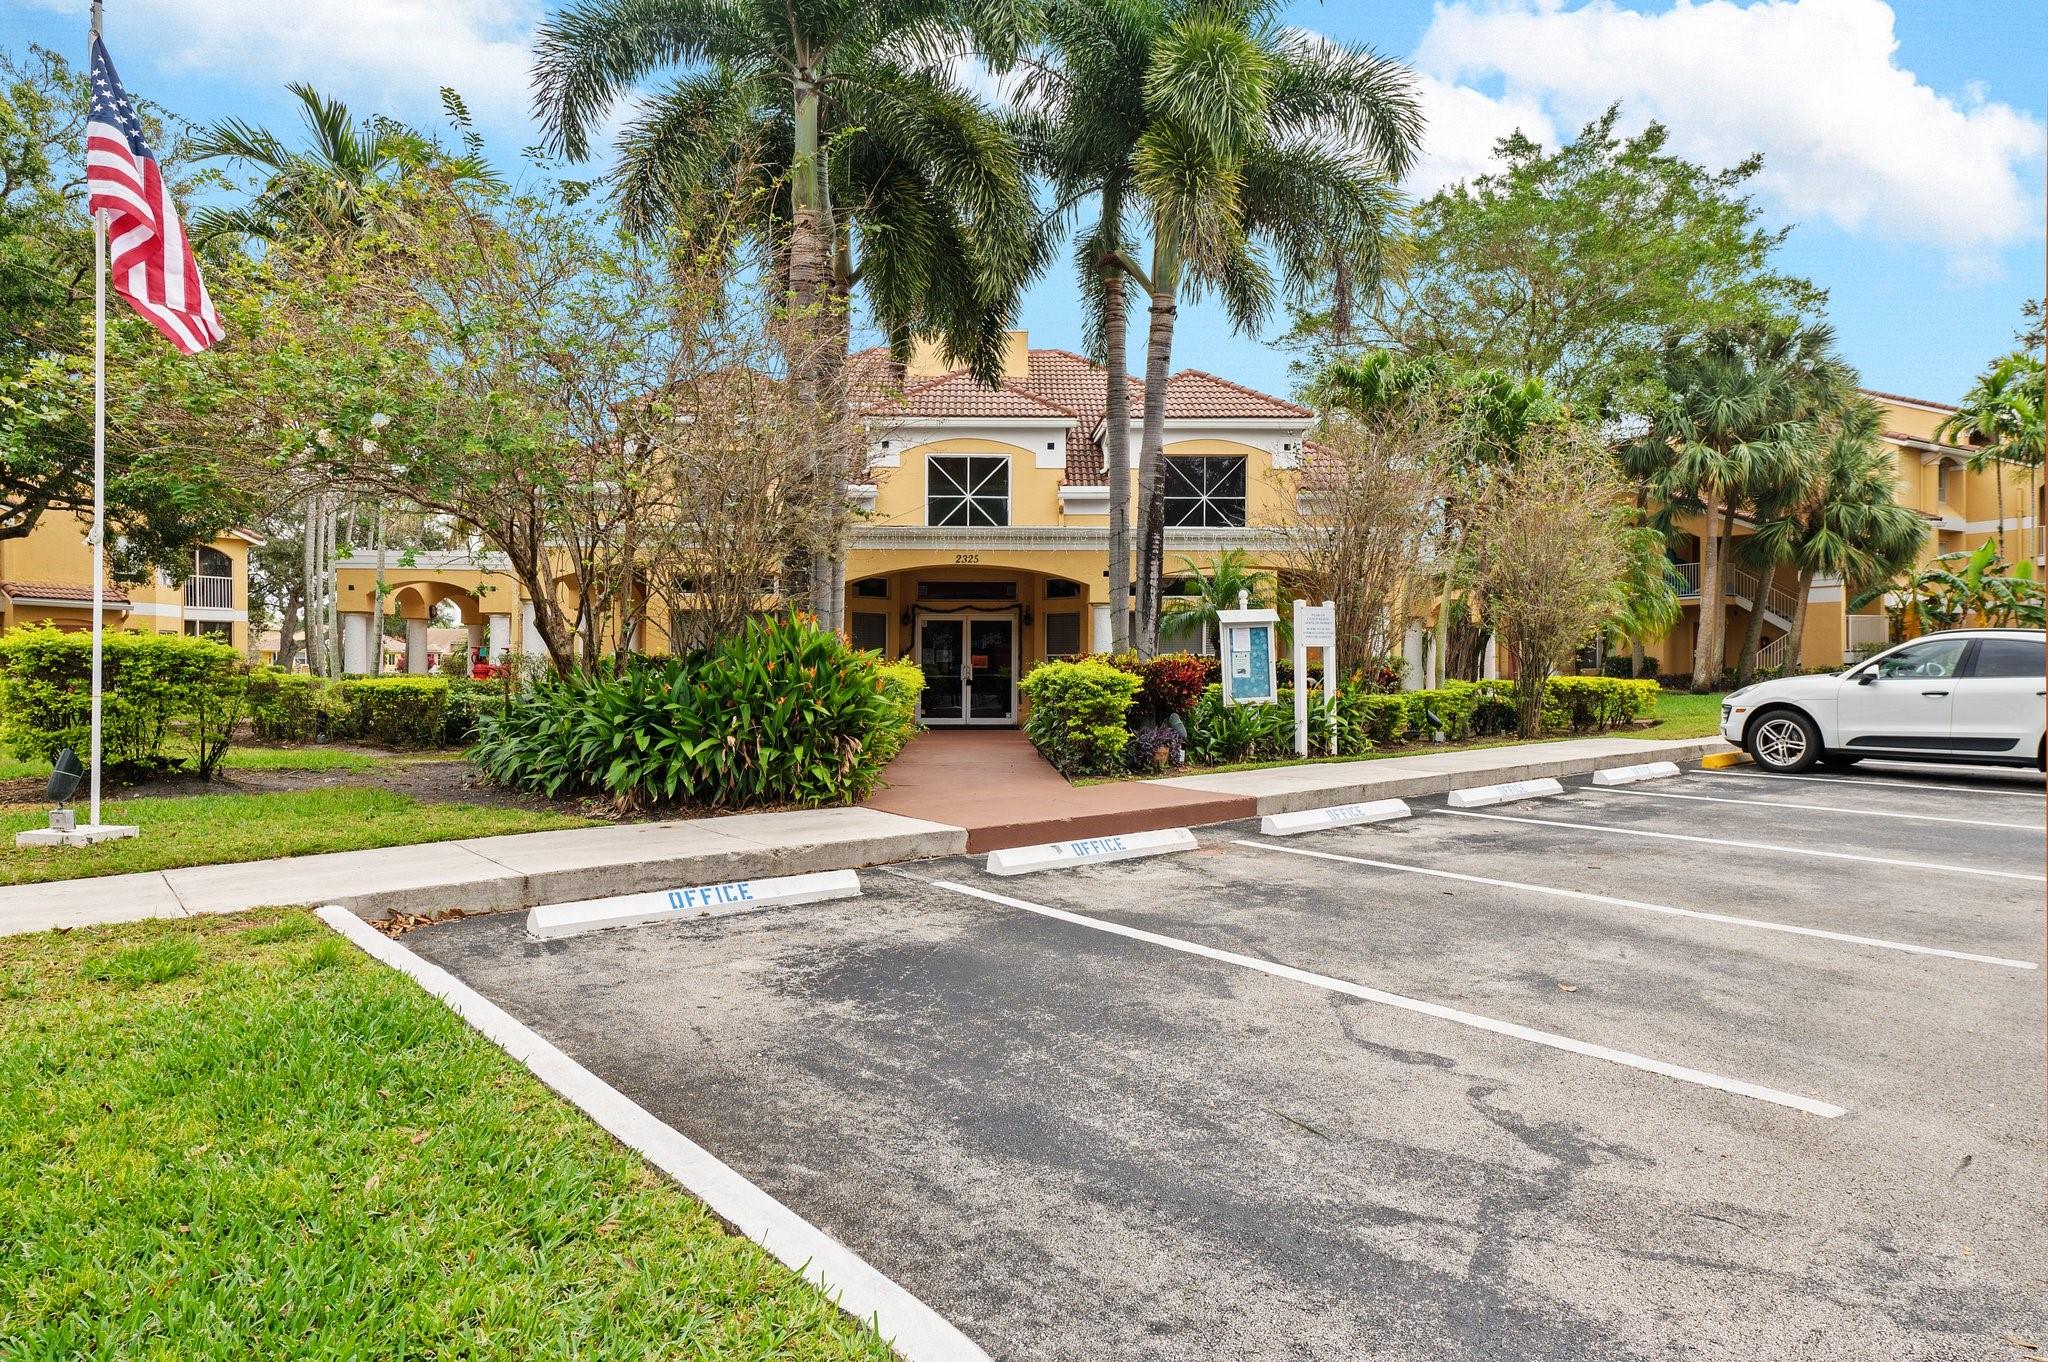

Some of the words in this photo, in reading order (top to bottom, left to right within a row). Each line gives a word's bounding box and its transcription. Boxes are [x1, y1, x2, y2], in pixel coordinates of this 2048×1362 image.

[955, 554, 979, 564] 2325
[1326, 805, 1366, 820] OFFICE
[1071, 837, 1127, 856] OFFICE
[668, 883, 754, 909] OFFICE
